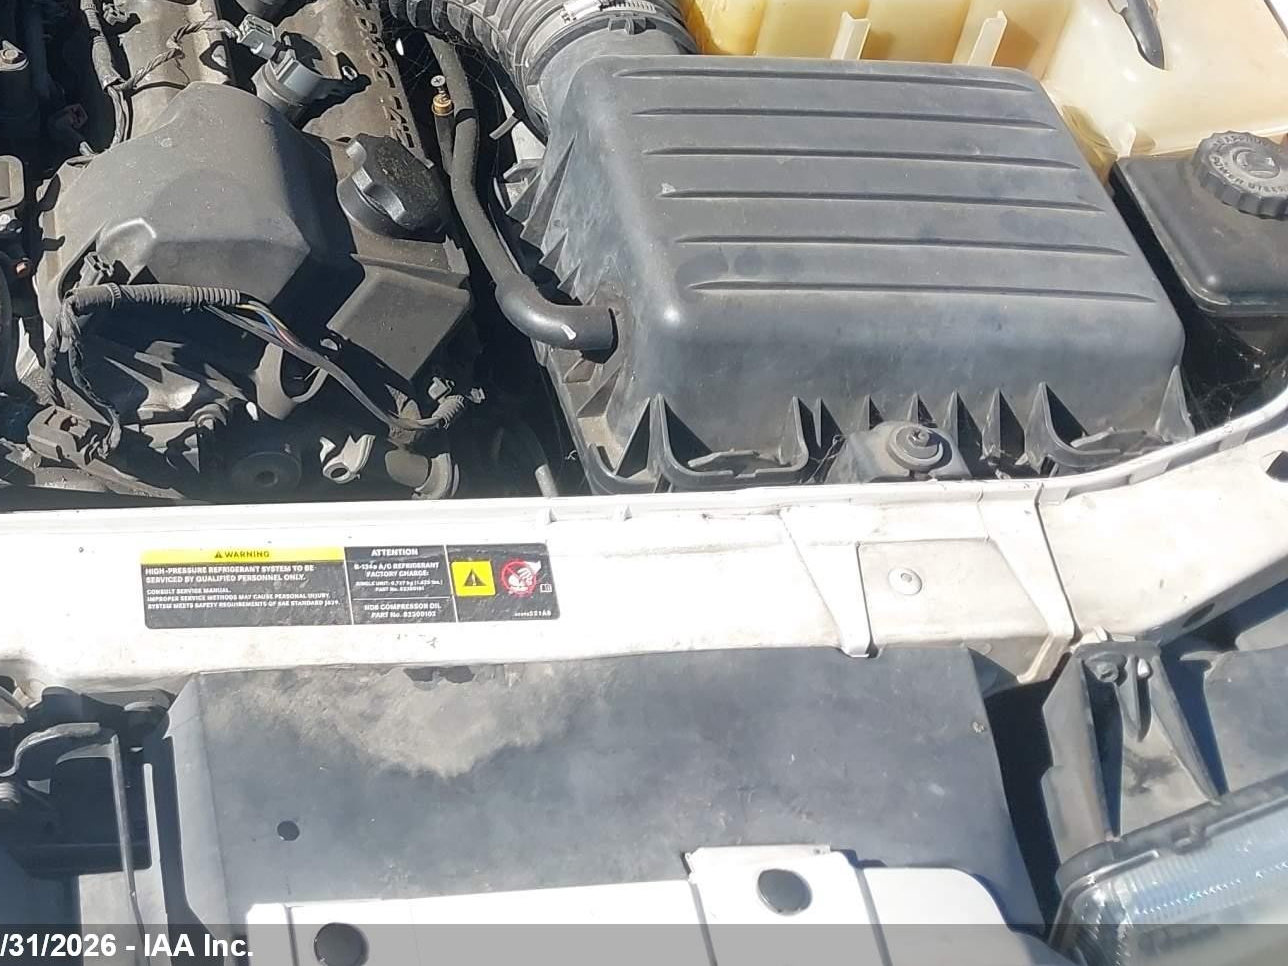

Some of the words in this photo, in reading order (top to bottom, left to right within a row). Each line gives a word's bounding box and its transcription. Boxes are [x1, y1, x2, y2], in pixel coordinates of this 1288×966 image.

[224, 550, 270, 558] WARNING
[371, 548, 418, 556] ATTENTION
[145, 566, 207, 575] HIGH-PRESSURE
[208, 565, 260, 574] REFRIGERANT
[261, 565, 292, 573] SYSTEM
[145, 576, 183, 584] SERVICED
[184, 575, 194, 583] BY
[195, 575, 236, 583] QUALIFIED
[237, 574, 282, 582] PERSONNEL
